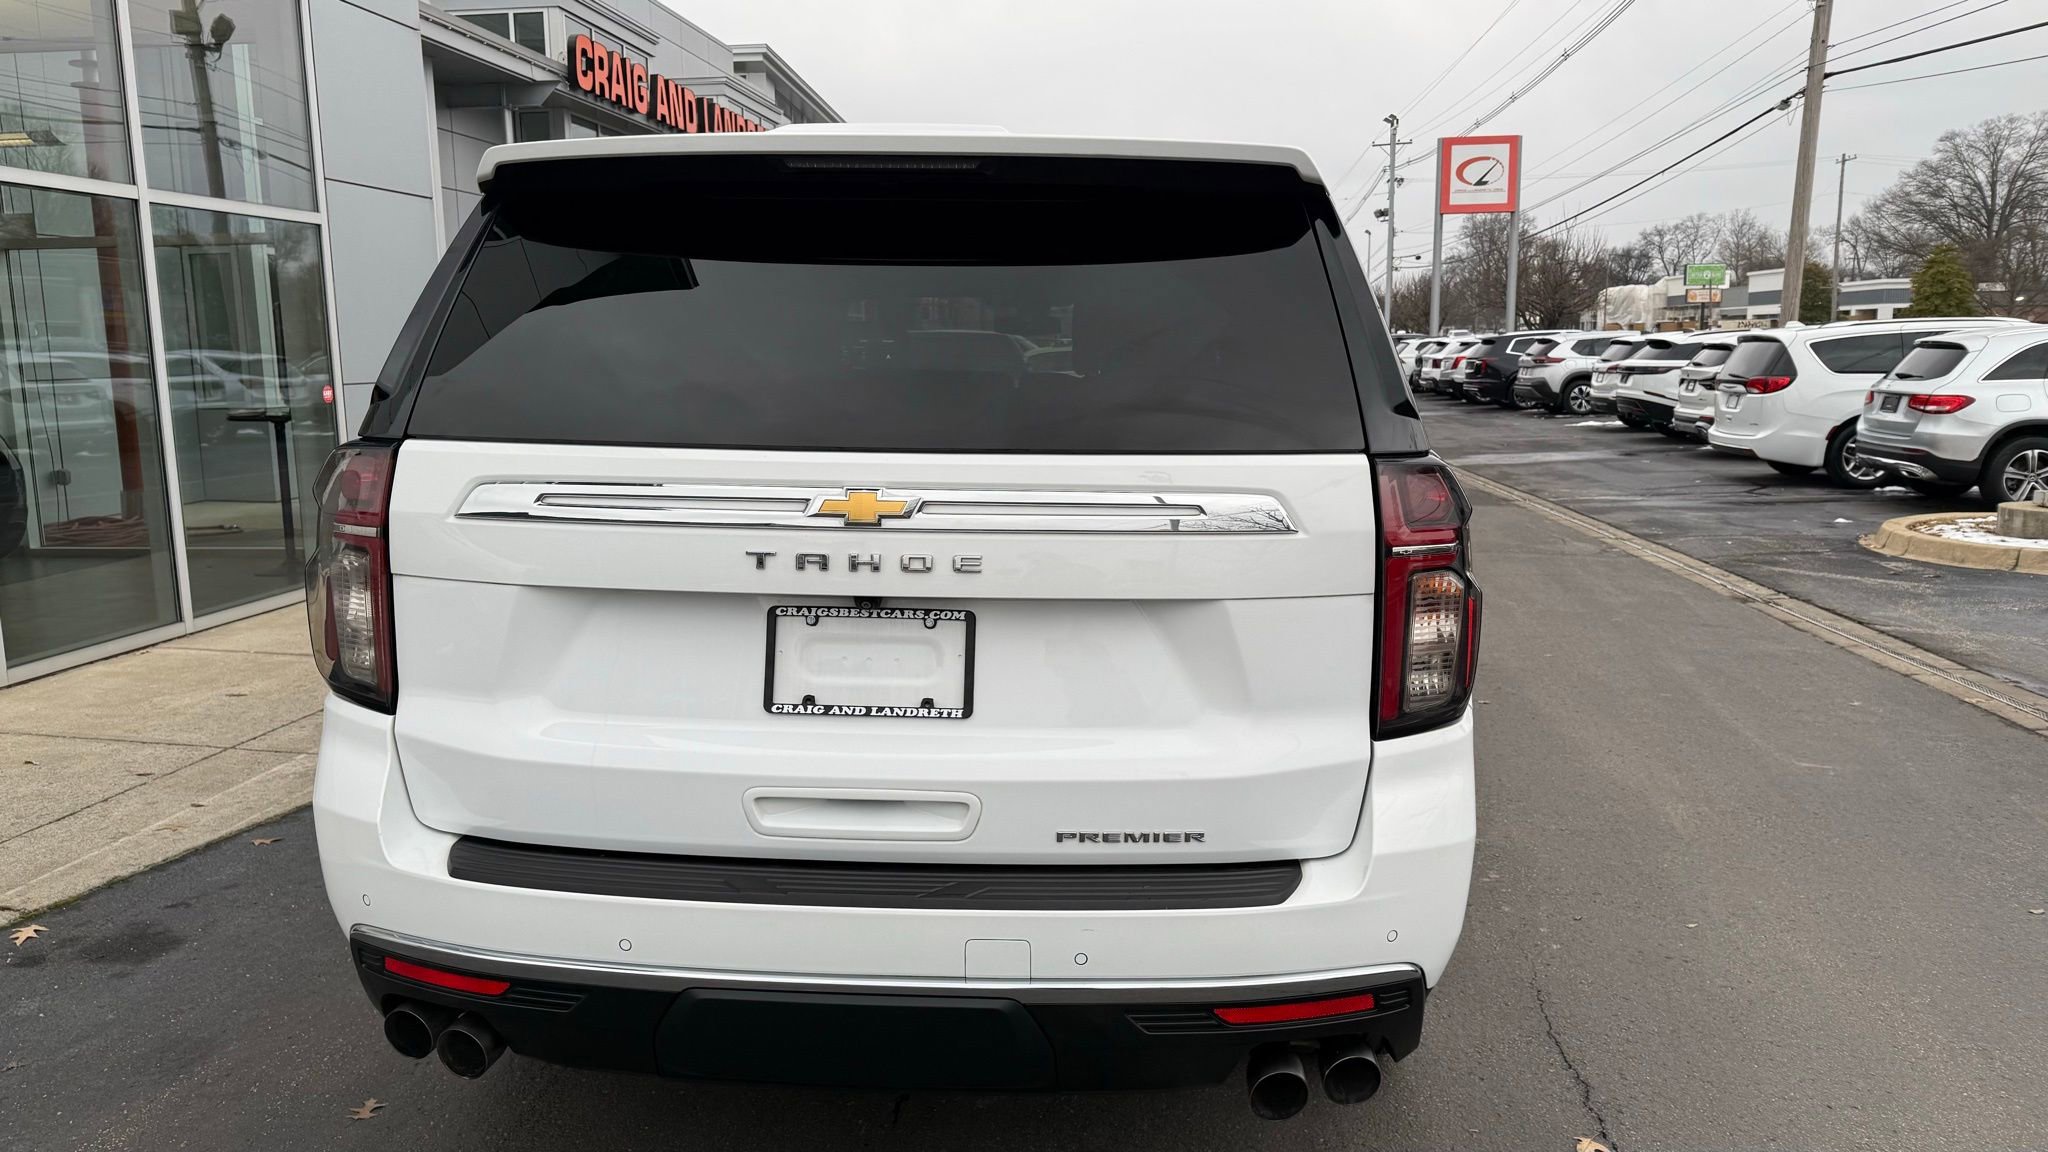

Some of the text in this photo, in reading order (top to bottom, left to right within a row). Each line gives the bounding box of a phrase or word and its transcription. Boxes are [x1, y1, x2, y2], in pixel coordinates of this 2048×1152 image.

[574, 34, 650, 115] CRAIG
[656, 74, 698, 133] AND
[745, 551, 983, 573] TAHOE
[775, 606, 967, 620] CRAIGSBESTCARS.COM
[771, 704, 964, 718] CRAIG AND LANDRETH
[1056, 831, 1206, 843] PREMIER
